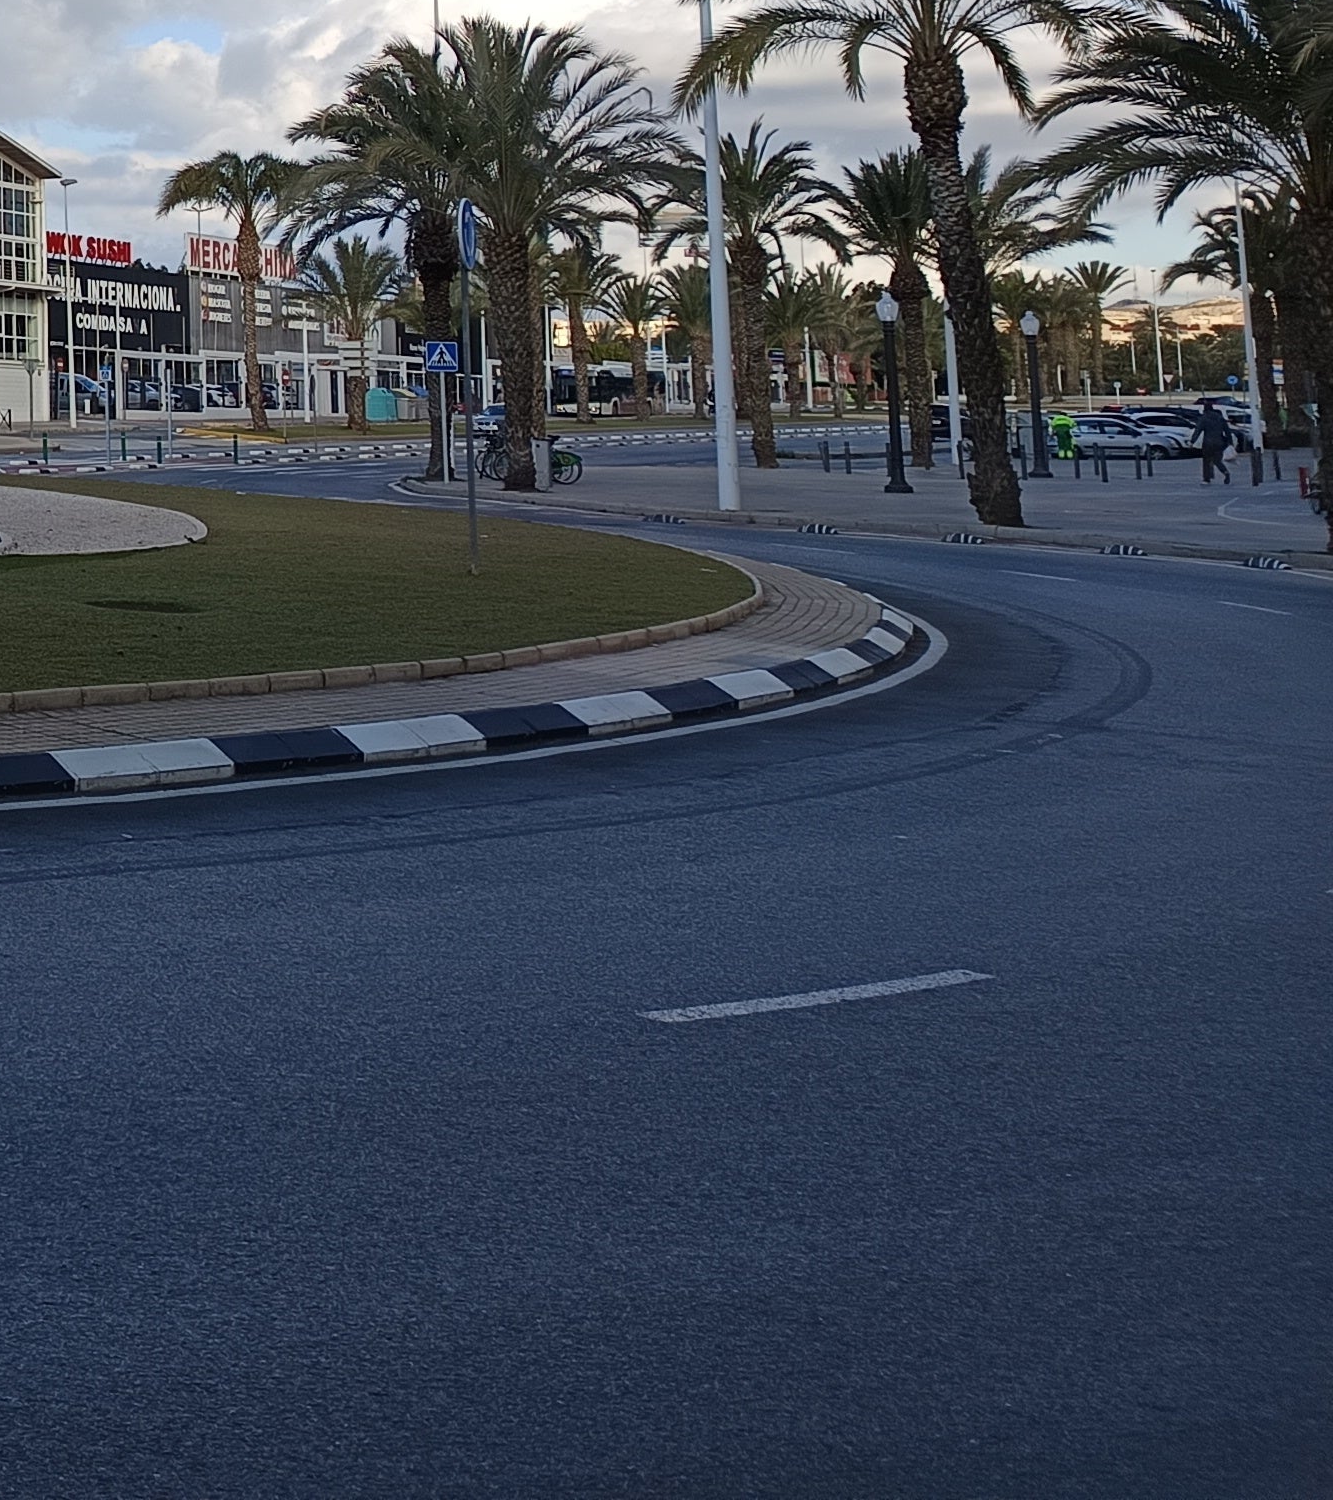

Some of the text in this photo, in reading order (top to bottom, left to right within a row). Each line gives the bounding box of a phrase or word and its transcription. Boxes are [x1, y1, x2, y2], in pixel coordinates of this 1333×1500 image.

[46, 231, 132, 264] WOK SUSHI
[117, 316, 149, 335] SAA
